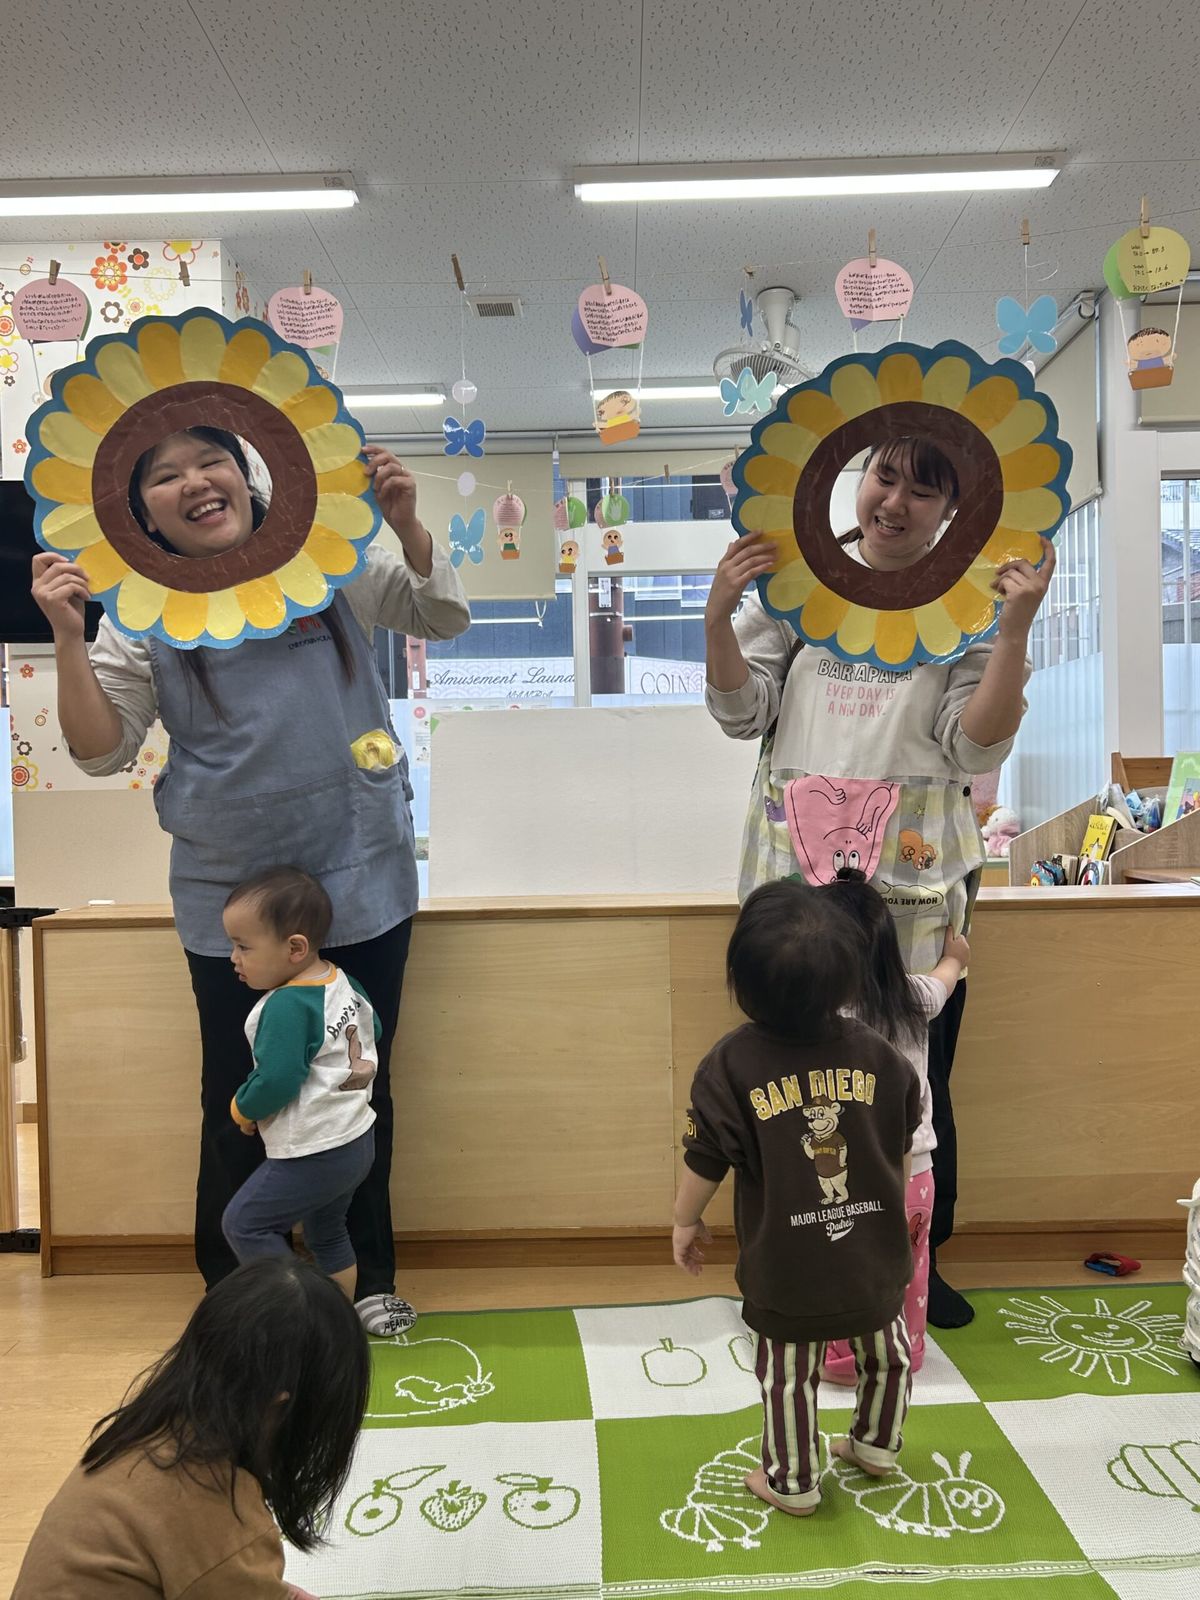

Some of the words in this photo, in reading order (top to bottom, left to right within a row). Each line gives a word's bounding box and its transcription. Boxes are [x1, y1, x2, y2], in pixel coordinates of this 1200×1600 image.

[430, 669, 518, 686] Amusement
[640, 671, 690, 695] COIN
[857, 686, 882, 702] DAY
[885, 687, 896, 701] IS
[828, 701, 835, 714] A
[900, 897, 917, 906] ARE
[918, 896, 938, 905] HOW
[749, 1073, 804, 1122] SAN
[807, 1068, 877, 1106] DIEGO
[790, 1211, 818, 1227] MAJOR
[817, 1206, 847, 1222] LEAGUE
[845, 1199, 883, 1217] BASEBALL
[825, 1217, 854, 1239] Padres
